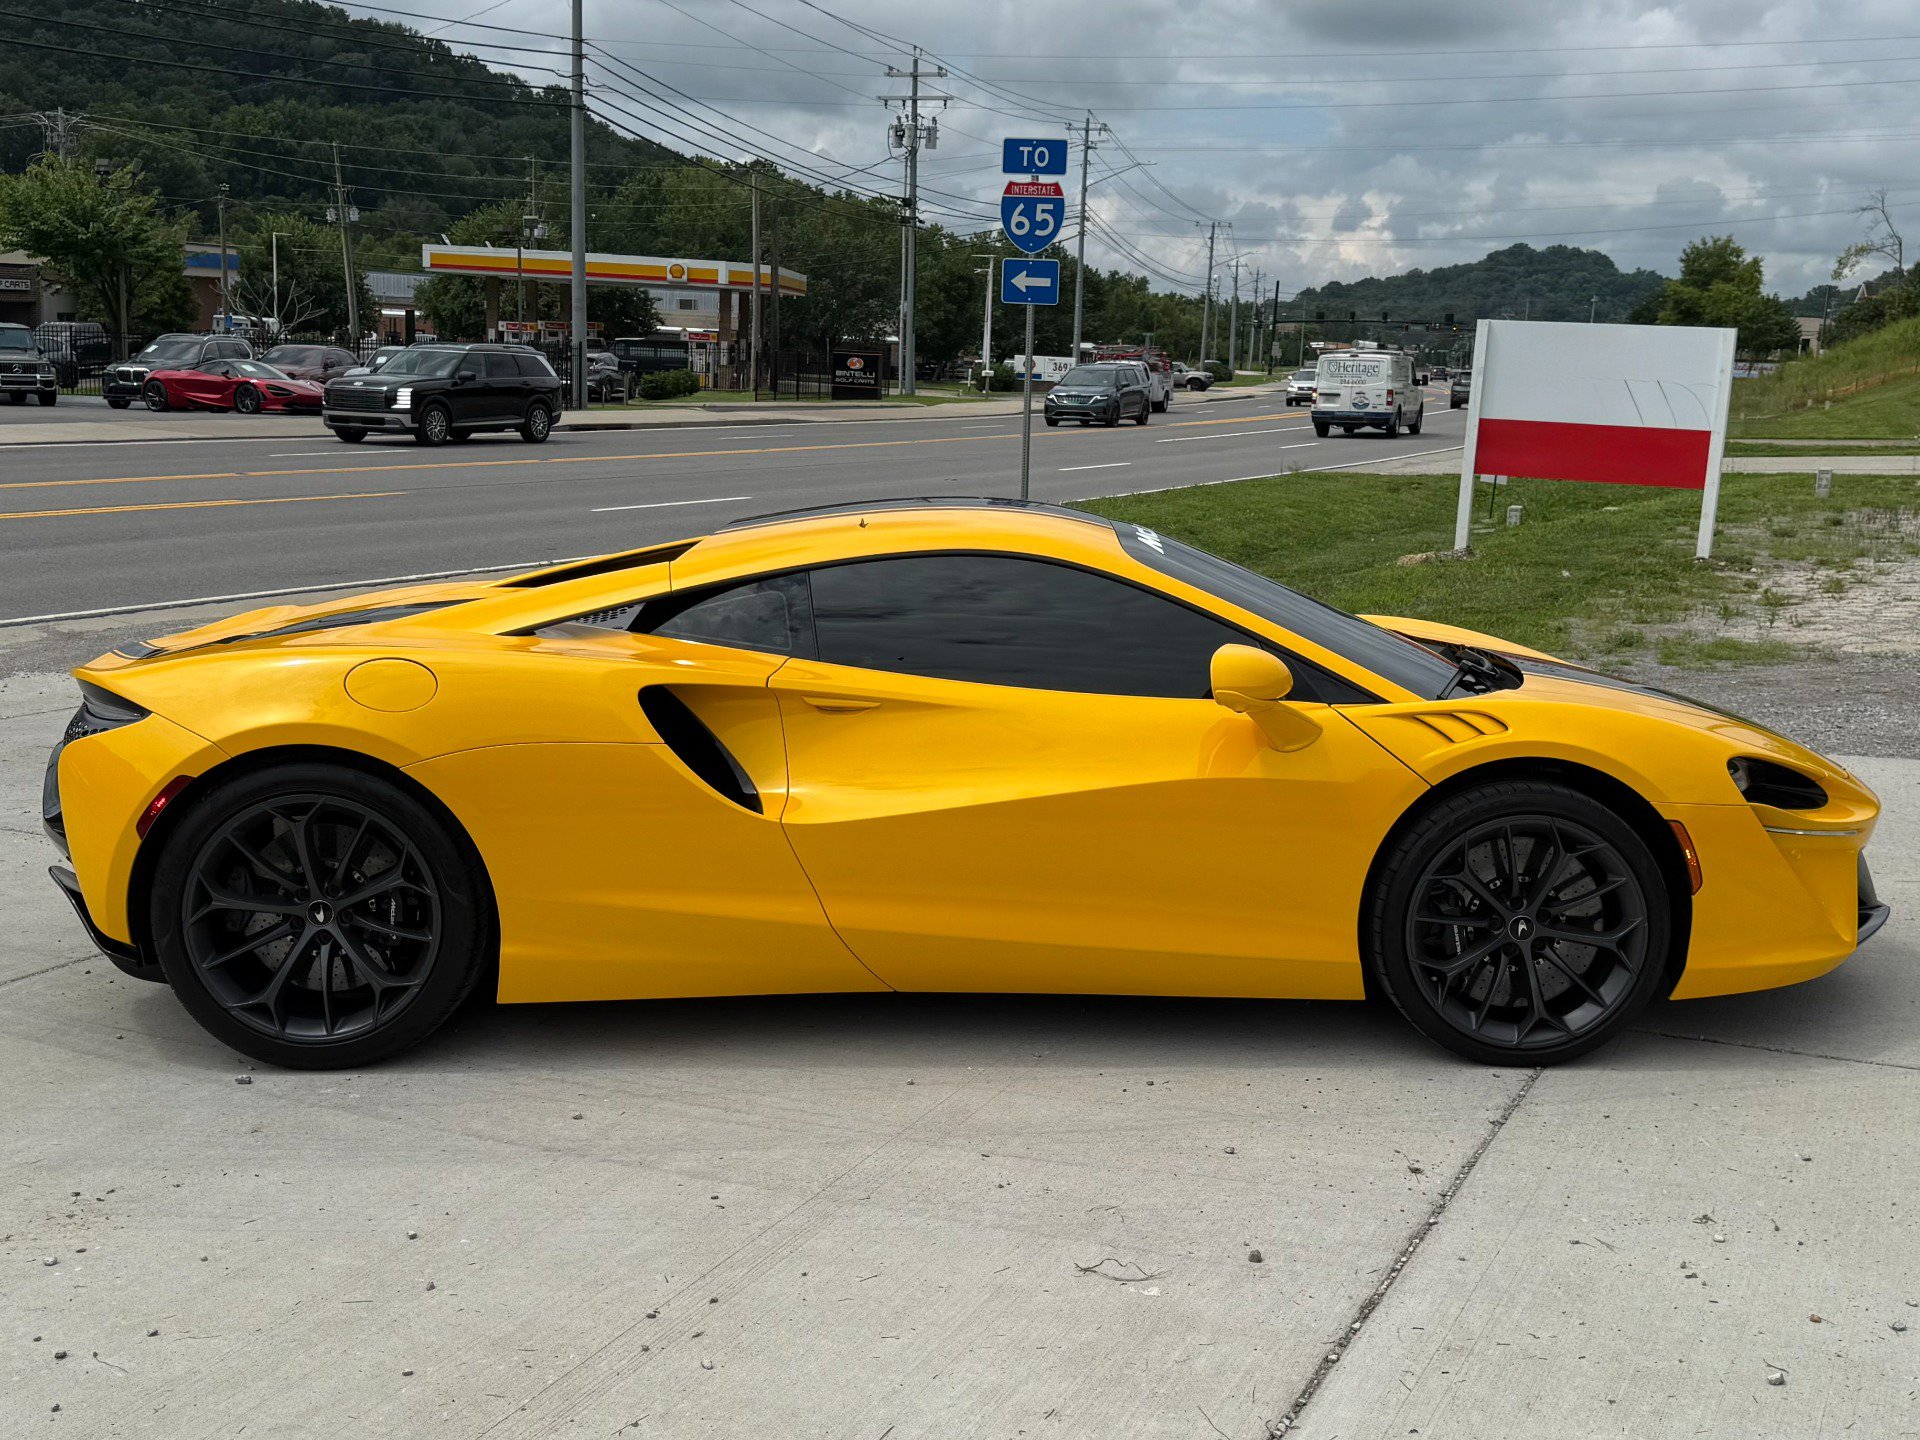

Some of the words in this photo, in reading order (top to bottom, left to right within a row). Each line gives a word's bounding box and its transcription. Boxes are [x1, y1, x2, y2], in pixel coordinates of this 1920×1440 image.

[1019, 147, 1049, 167] TO
[1011, 184, 1056, 196] INTERSTATE
[1010, 202, 1055, 237] 65
[4, 280, 29, 288] CARTS
[835, 370, 876, 378] BINTELLI
[1338, 361, 1379, 377] Heritage
